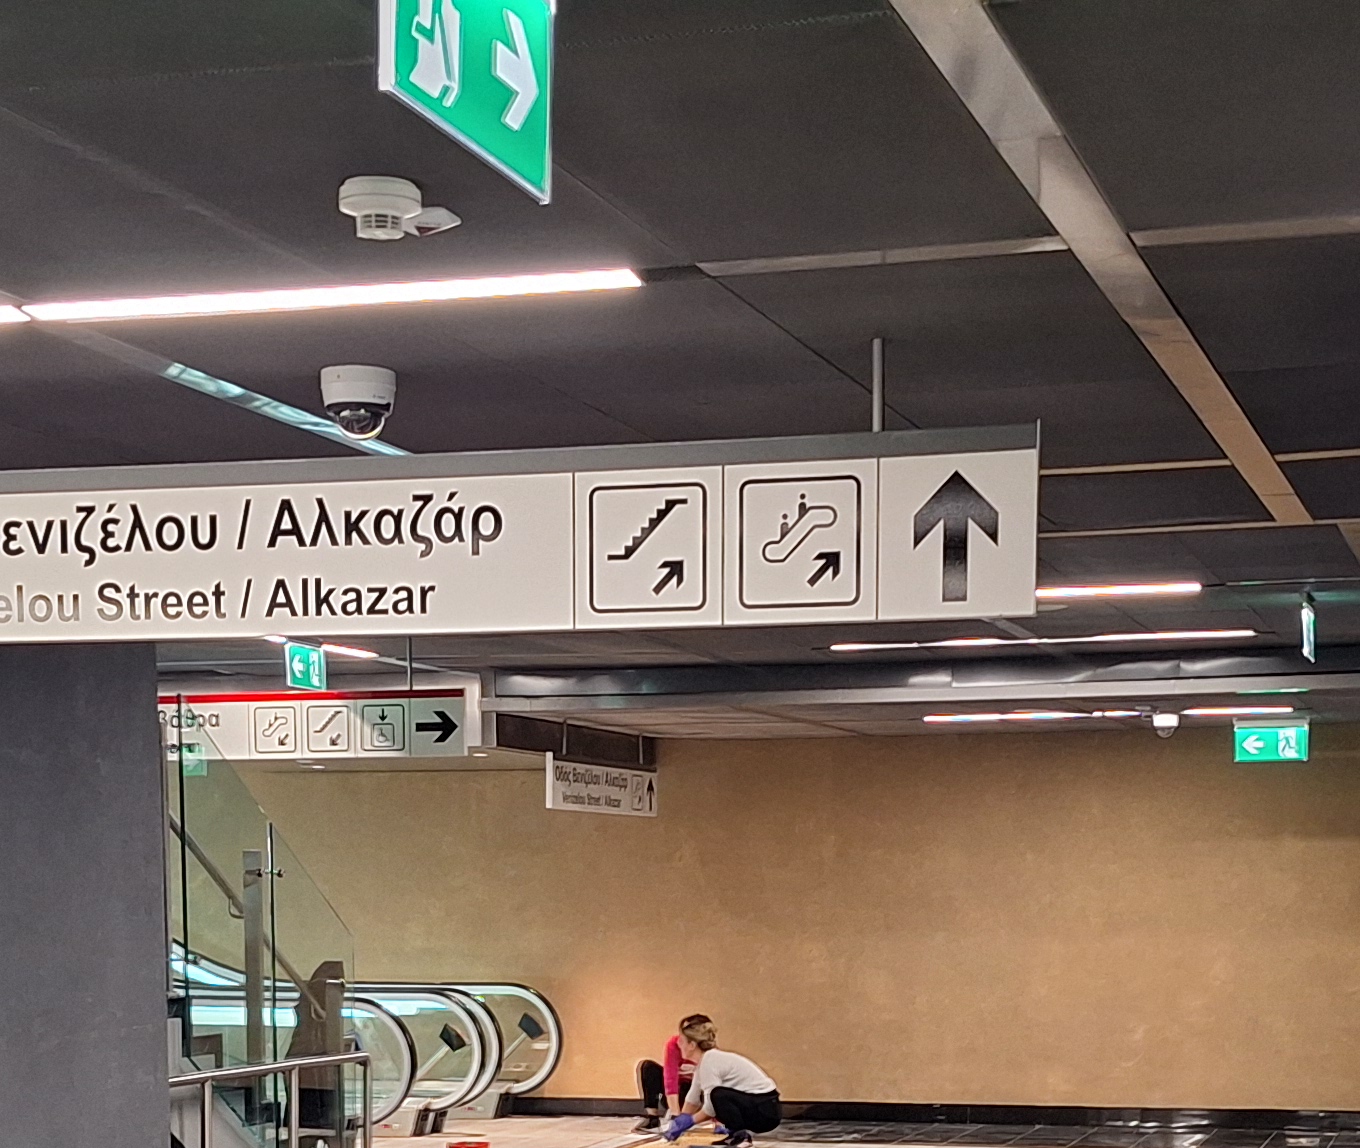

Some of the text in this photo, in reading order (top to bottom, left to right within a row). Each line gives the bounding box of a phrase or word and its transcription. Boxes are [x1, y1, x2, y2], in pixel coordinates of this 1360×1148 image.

[236, 498, 252, 550] /
[266, 491, 503, 558] Αλκαζάρ
[96, 582, 227, 621] Street
[240, 578, 253, 619] /
[265, 577, 436, 618] Alkazar
